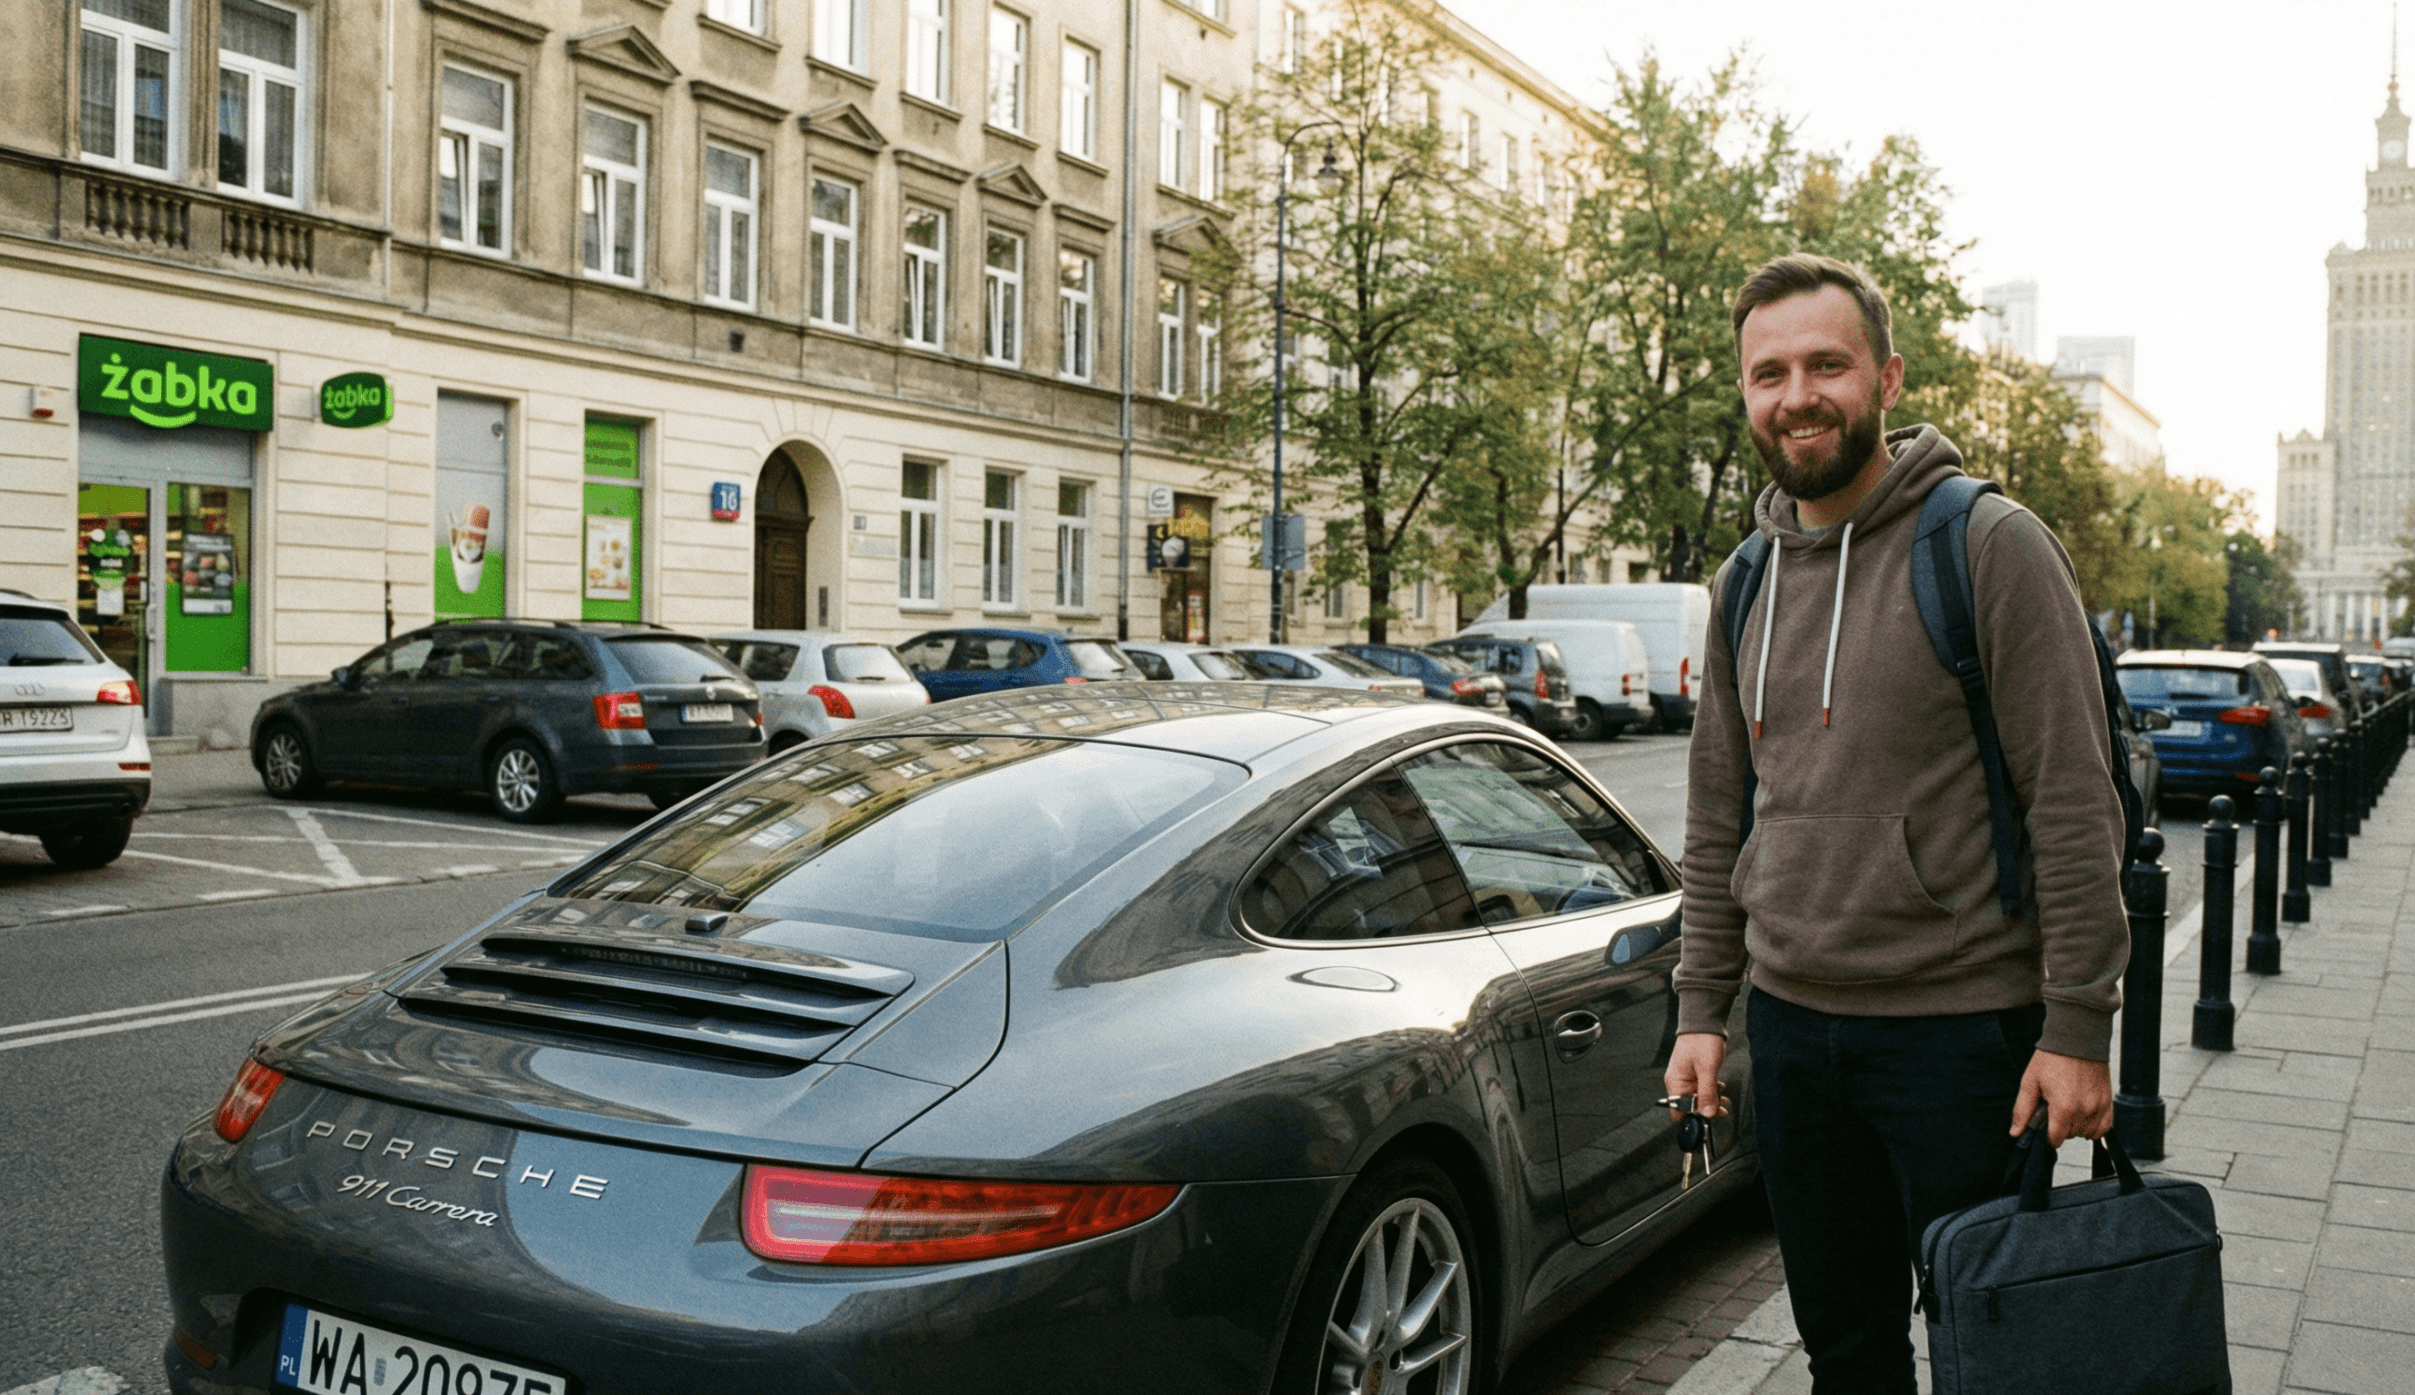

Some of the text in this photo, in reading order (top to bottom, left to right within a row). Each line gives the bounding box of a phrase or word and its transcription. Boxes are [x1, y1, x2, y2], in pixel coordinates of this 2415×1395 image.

[101, 353, 257, 415] żabka
[325, 384, 381, 409] żabka
[719, 490, 738, 511] 16
[306, 1120, 609, 1200] PORSCHE
[337, 1174, 499, 1228] 911 Carrera
[280, 1354, 297, 1376] PL
[309, 1319, 367, 1395] WA
